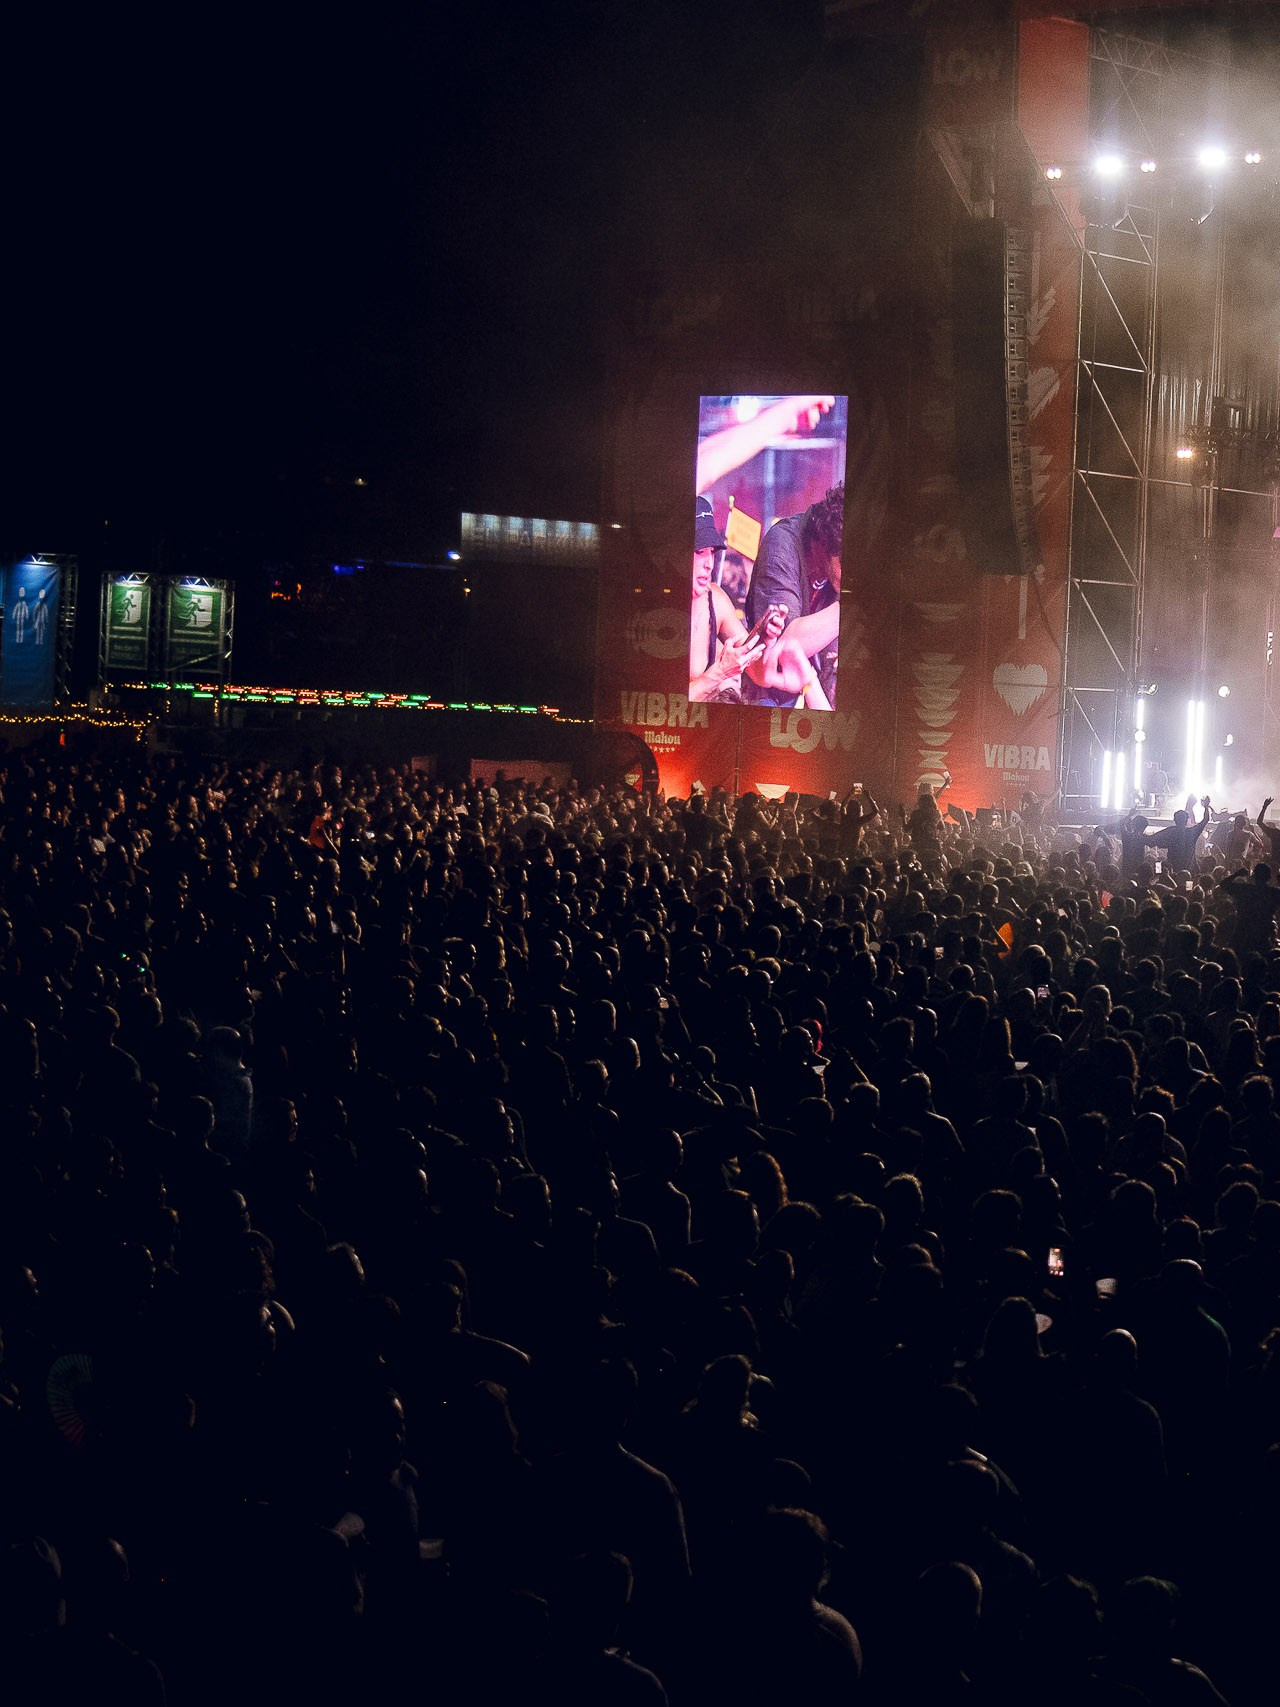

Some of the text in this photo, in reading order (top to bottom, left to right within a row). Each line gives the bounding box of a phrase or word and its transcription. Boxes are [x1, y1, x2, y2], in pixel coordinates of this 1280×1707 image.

[620, 690, 709, 728] VIBRA
[644, 730, 681, 745] Mahou
[769, 707, 861, 754] LOW
[983, 743, 1051, 771] VIBRA
